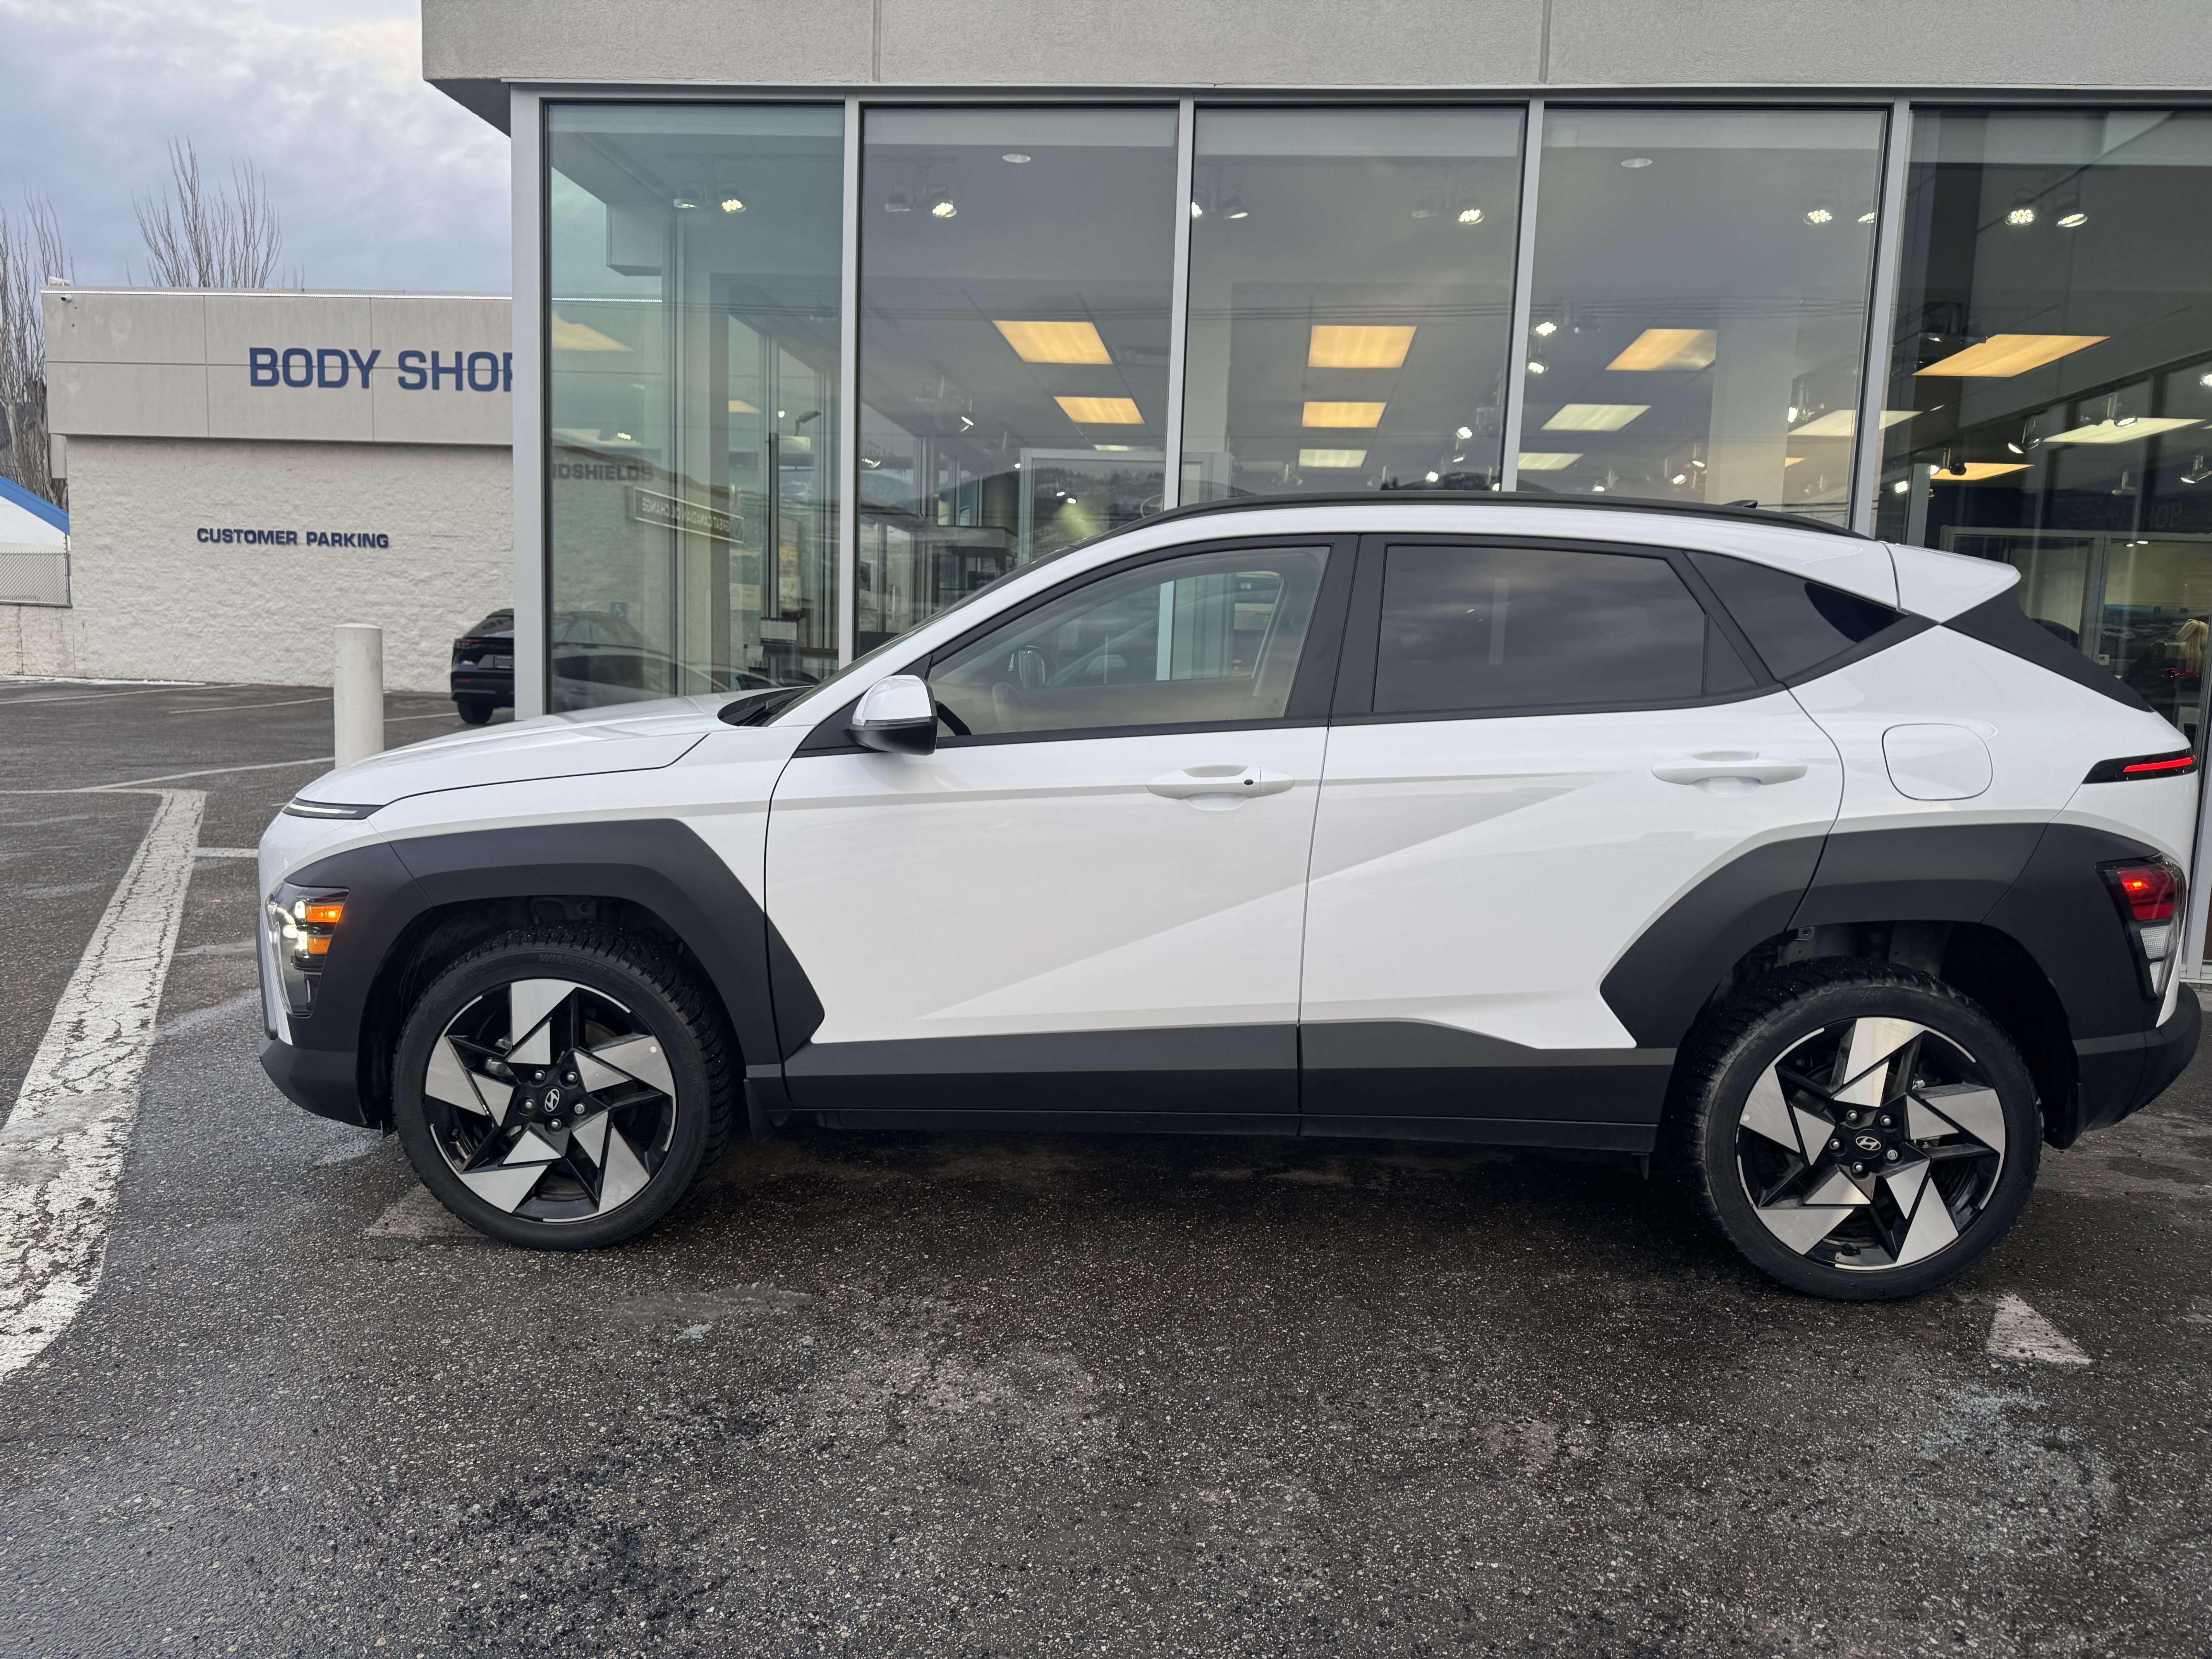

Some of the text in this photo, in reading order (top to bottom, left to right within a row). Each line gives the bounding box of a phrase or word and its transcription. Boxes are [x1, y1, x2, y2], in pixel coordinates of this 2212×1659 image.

[249, 347, 381, 388] BODY
[197, 528, 389, 548] CUSTOMER PARKING
